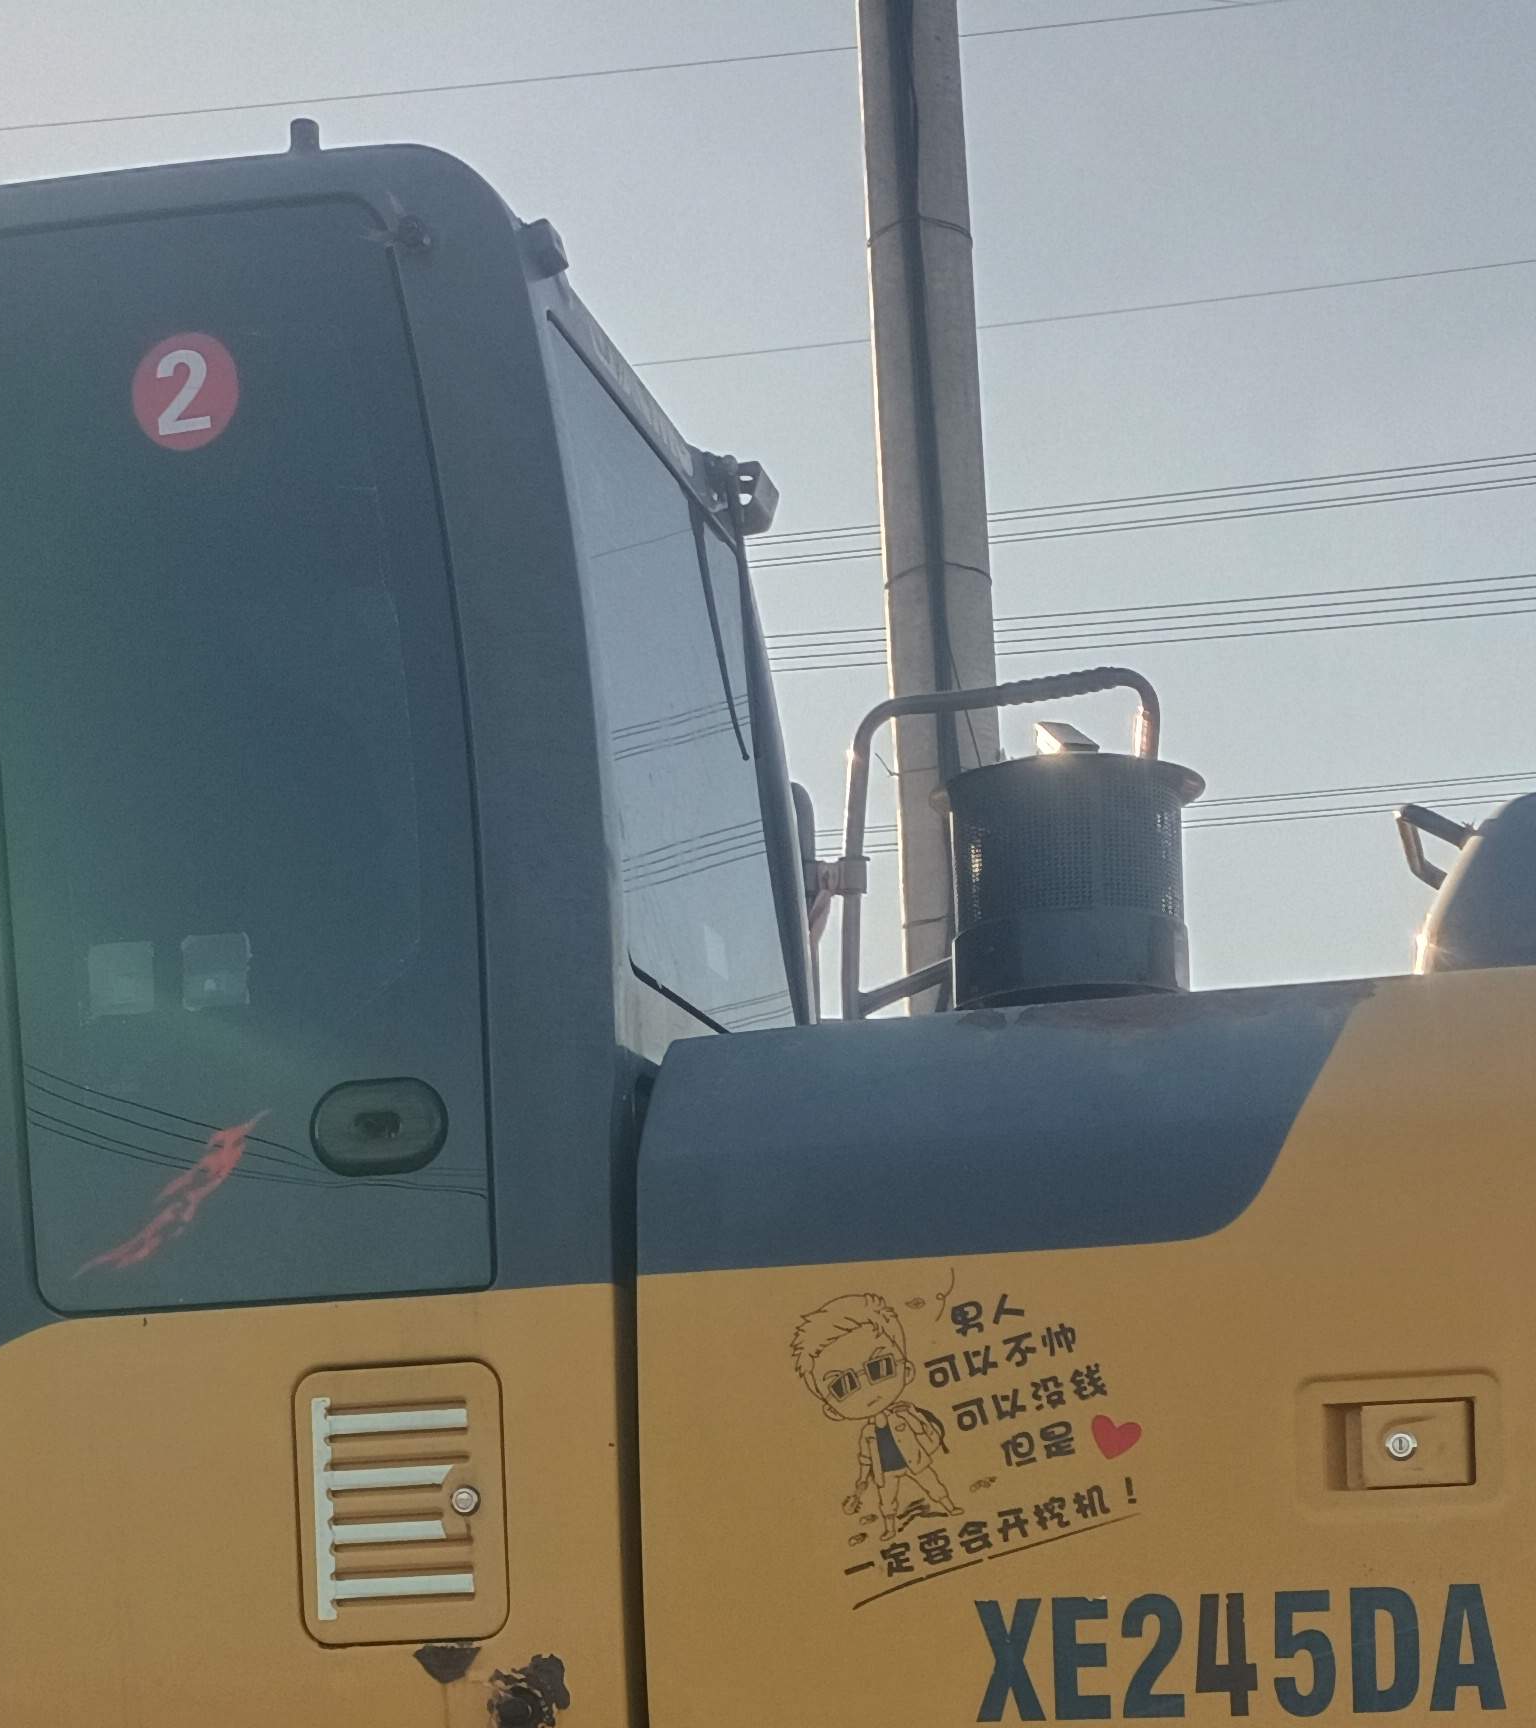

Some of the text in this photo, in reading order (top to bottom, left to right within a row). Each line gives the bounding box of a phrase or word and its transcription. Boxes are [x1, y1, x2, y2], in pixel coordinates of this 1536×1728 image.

[155, 349, 212, 436] 2
[924, 1322, 1077, 1388] 可以不帅
[951, 1362, 1108, 1432] 可以没钱
[1000, 1420, 1076, 1467] 但是
[975, 1583, 1507, 1723] XE245DA
